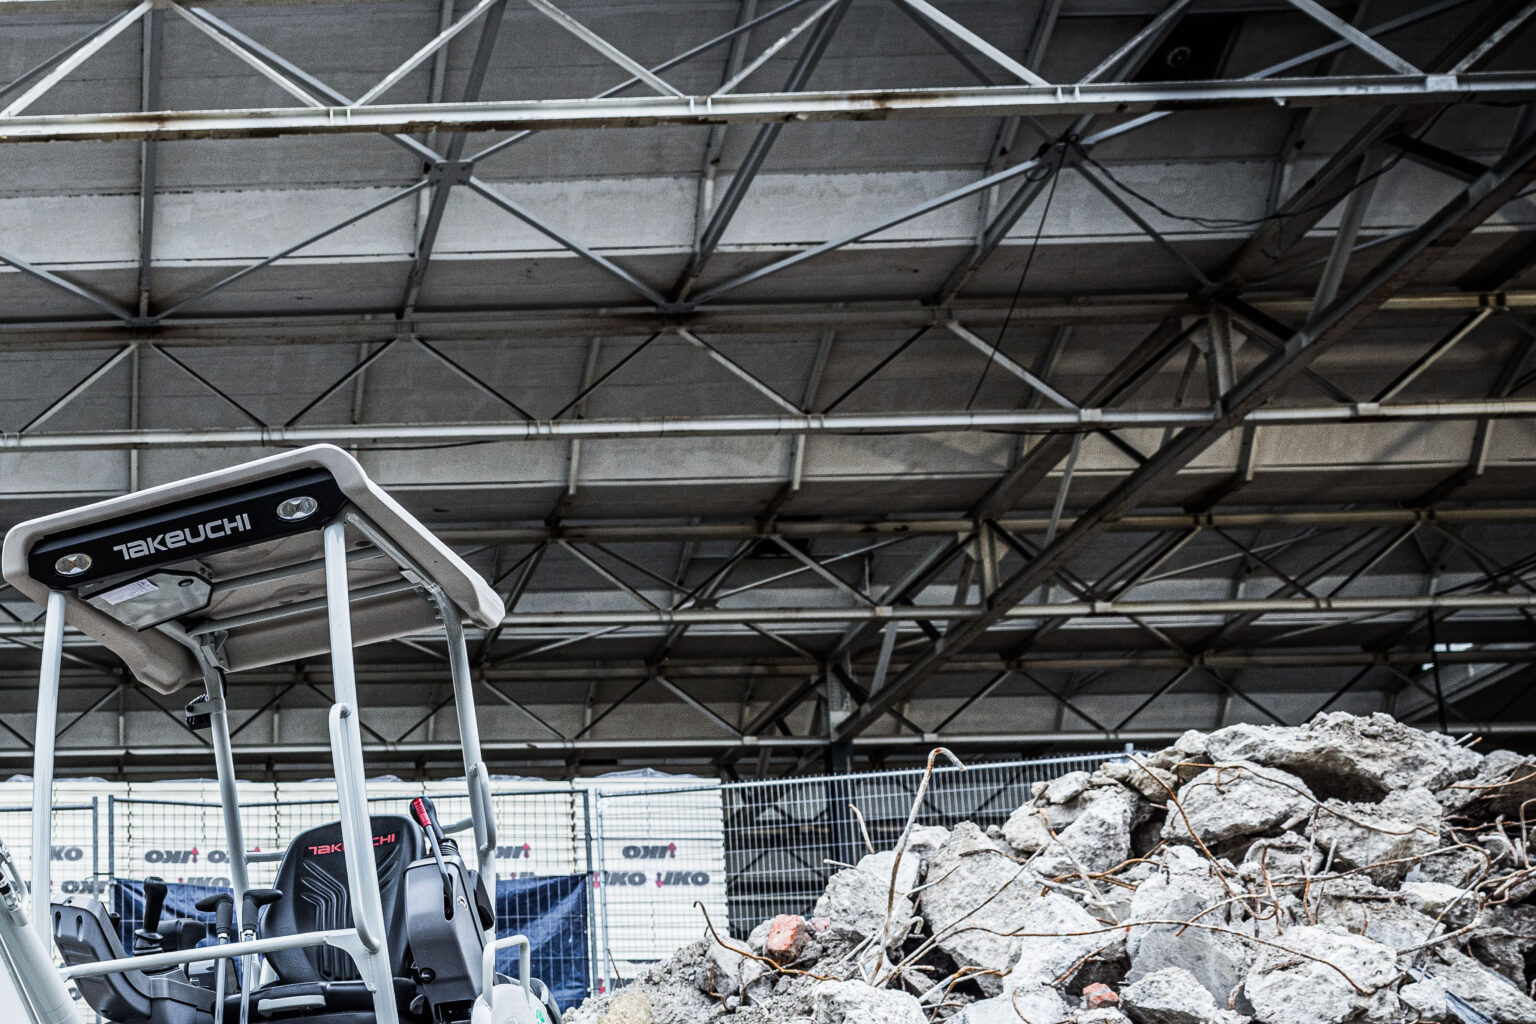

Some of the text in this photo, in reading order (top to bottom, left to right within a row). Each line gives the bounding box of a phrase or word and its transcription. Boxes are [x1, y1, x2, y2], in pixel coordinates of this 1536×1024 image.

[308, 833, 396, 855] TAKCHI
[51, 846, 83, 861] KO
[144, 850, 192, 863] IKO
[622, 846, 670, 859] IKO
[663, 872, 710, 886] IKO
